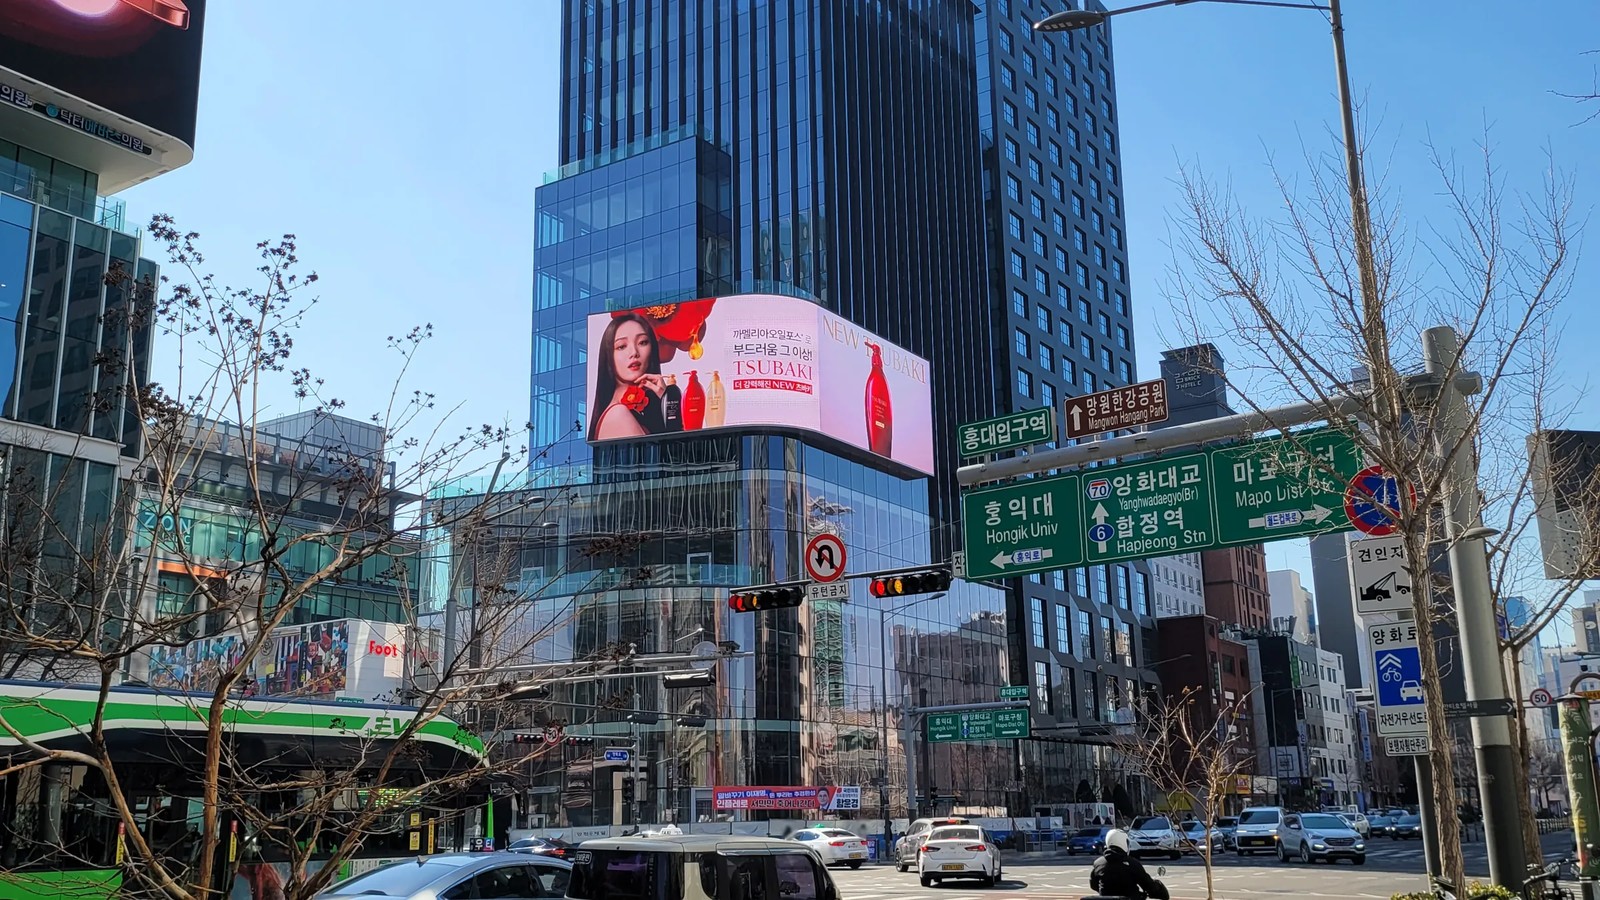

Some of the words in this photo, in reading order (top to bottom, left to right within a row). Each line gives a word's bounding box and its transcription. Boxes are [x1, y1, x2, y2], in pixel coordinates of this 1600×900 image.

[1, 85, 29, 108] 의원
[61, 109, 144, 153] 닥터에버스의원
[733, 343, 778, 357] 부드러움
[780, 345, 790, 356] 그
[793, 346, 813, 361] 이상!
[824, 315, 860, 350] NEW
[863, 335, 926, 384] TUBAKI
[733, 360, 812, 380] TSUBAKI
[773, 381, 796, 391] NEW
[1087, 382, 1164, 417] 망원한강공원
[1089, 412, 1119, 431] Mangwon
[1121, 405, 1148, 427] Hangang
[1150, 401, 1165, 419] Park
[964, 412, 1047, 453] 홍대입구역
[1113, 464, 1202, 497] 양화대교
[1092, 485, 1107, 497] 70
[1119, 486, 1199, 512] Yanghwadaegyo(Br)
[1236, 490, 1272, 508] Mapo
[985, 492, 1054, 527] 홍익대
[1116, 507, 1184, 539] 합정역
[1267, 512, 1297, 527] 월드컵북로
[987, 526, 1028, 545] Hongik
[1031, 522, 1059, 539] Univ
[1097, 529, 1106, 539] 6
[1118, 535, 1177, 554] Hapjeong
[1184, 530, 1207, 543] Stn
[1016, 551, 1041, 563] 홍익로
[1359, 545, 1404, 563] 견인지
[812, 584, 847, 599] 유턴금지
[1372, 626, 1417, 646] 양화로
[369, 640, 397, 657] Foot
[1001, 687, 1027, 696] 홍대입구역
[1534, 694, 1548, 703] 50
[375, 716, 413, 736] EV
[998, 713, 1022, 722] 마포구청
[1388, 738, 1428, 753] 보행자횡단주의
[717, 799, 748, 808] 인플레로
[751, 799, 774, 808] 서민만
[777, 799, 815, 808] 죽어나간다
[836, 798, 859, 808] 함운경
